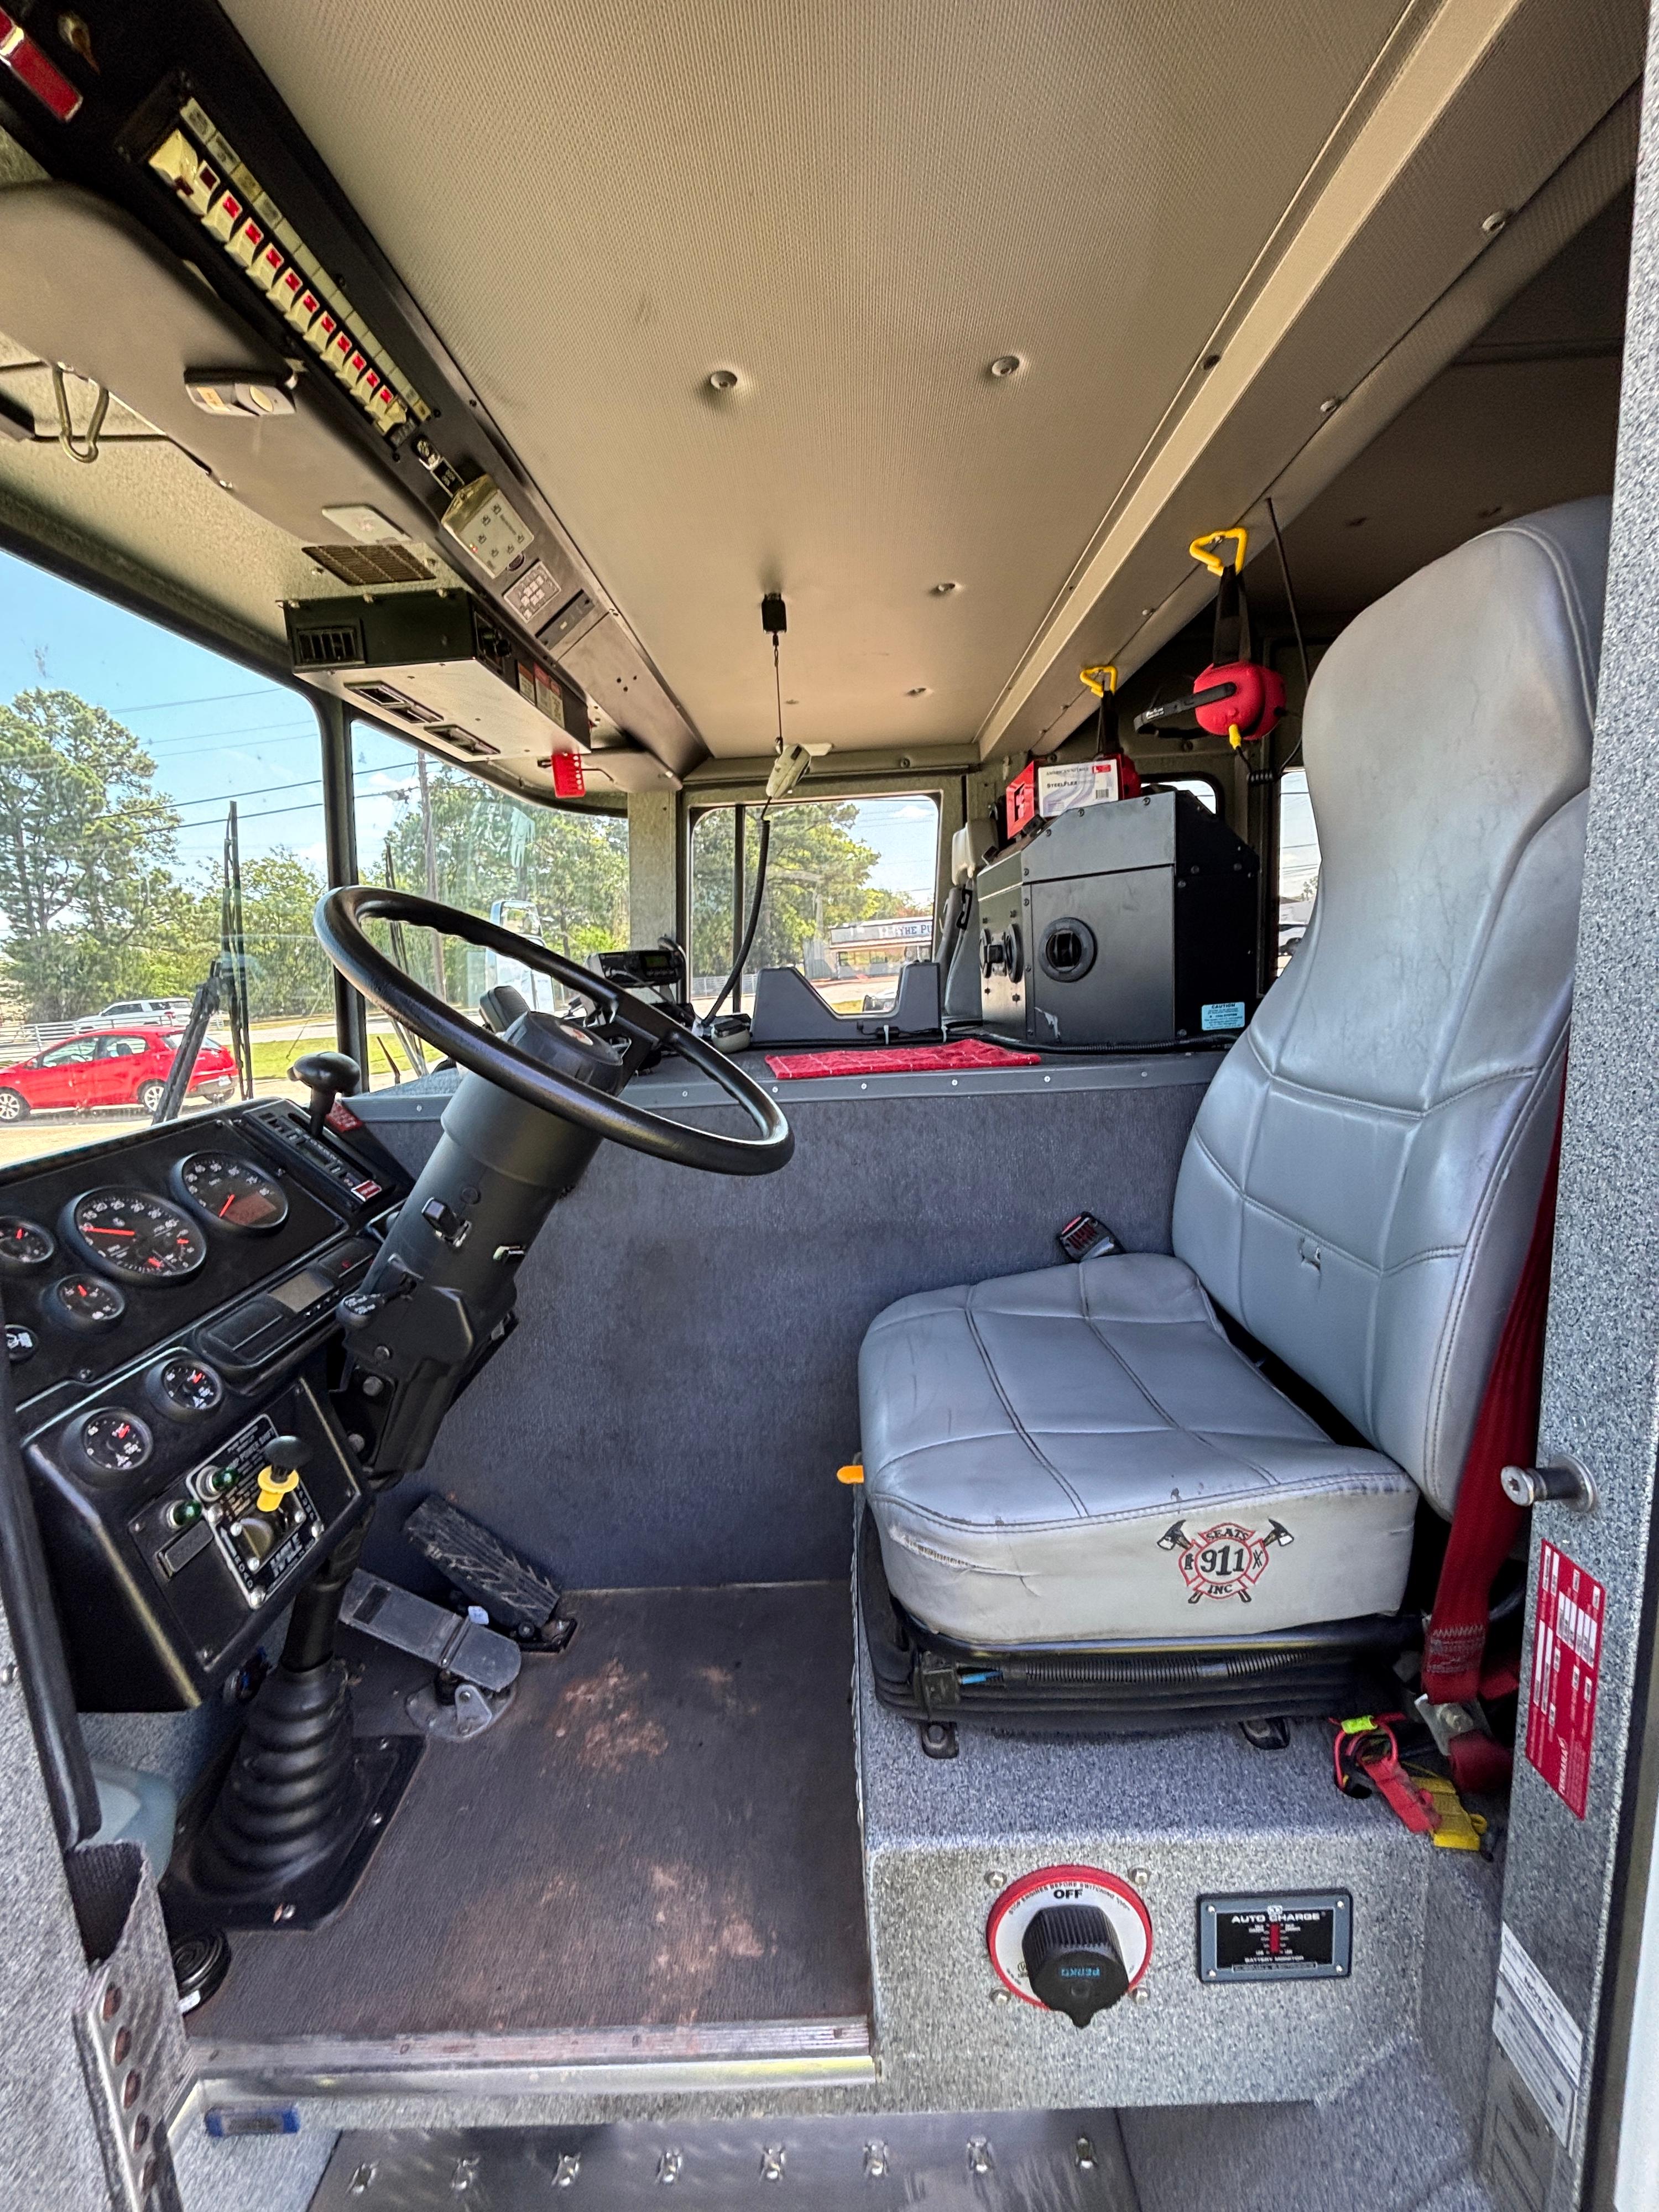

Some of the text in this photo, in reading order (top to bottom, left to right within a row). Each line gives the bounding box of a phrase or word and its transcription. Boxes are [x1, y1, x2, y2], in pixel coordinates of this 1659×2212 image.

[1206, 1528, 1250, 1541] SEATS
[1200, 1545, 1245, 1576] 911
[234, 1556, 254, 1588] ROAD
[1207, 1584, 1233, 1594] INC
[1053, 1889, 1083, 1900] OFF
[1231, 1913, 1320, 1923] AUTO CHARGE
